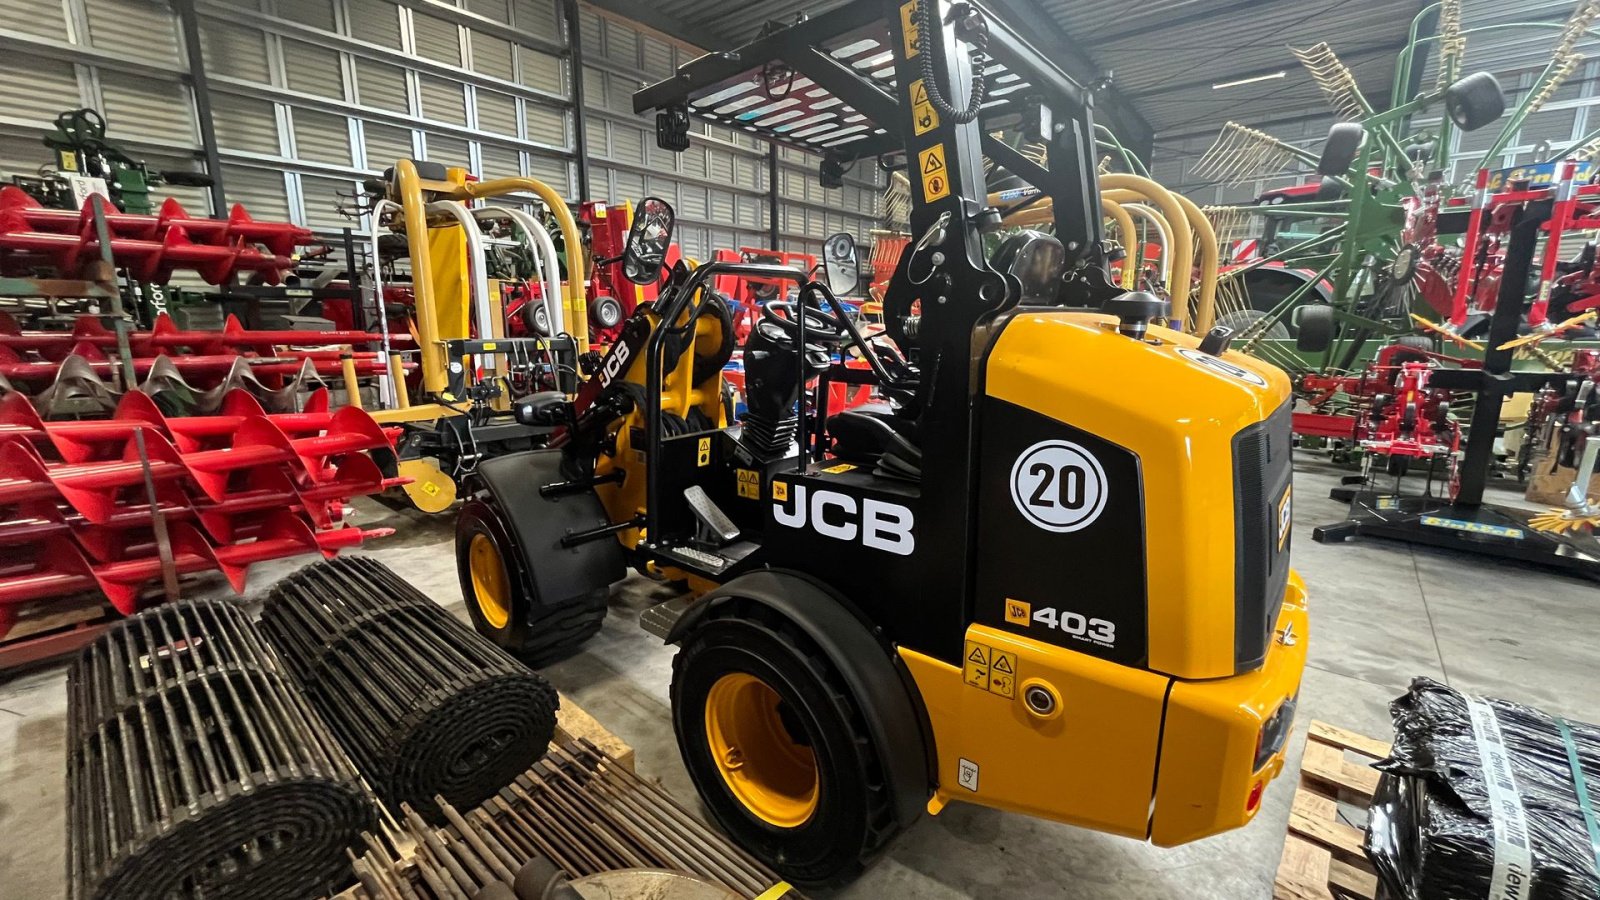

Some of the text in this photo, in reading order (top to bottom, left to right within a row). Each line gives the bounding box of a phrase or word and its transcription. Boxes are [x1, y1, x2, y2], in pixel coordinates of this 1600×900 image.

[601, 340, 630, 389] JCB
[1029, 462, 1086, 510] 20
[772, 484, 915, 556] JCB
[1032, 606, 1116, 644] 403
[1502, 862, 1527, 900] dew
